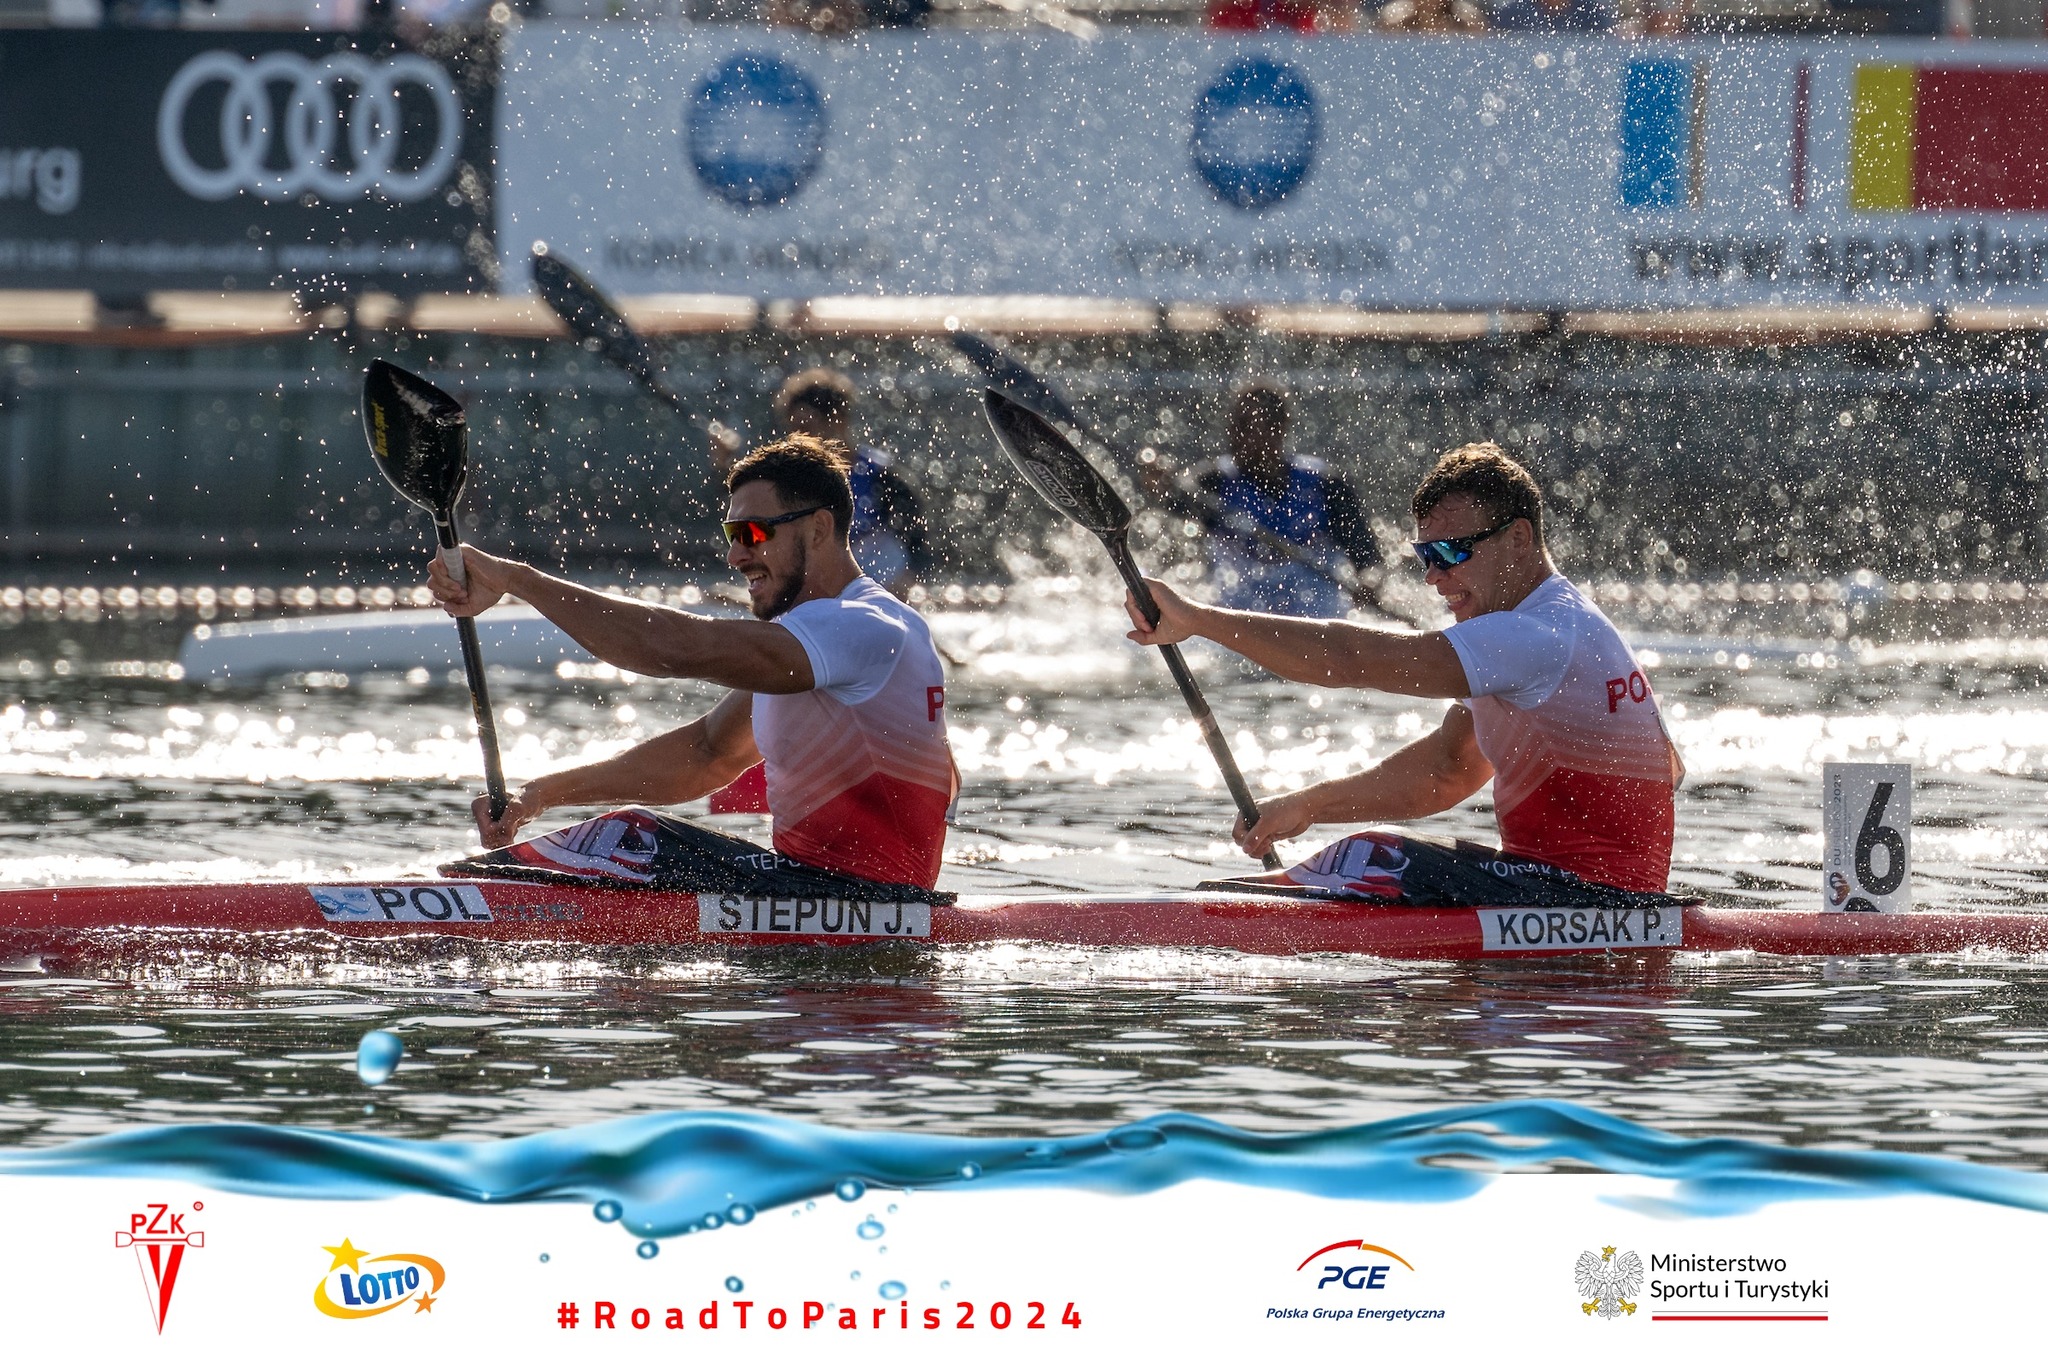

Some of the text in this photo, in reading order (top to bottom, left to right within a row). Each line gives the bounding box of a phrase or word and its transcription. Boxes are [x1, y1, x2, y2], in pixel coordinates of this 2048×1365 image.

[1605, 670, 1652, 714] PO
[1855, 782, 1906, 896] 6
[370, 887, 492, 921] POL
[717, 896, 913, 934] STEPUN J.
[1496, 909, 1665, 945] KORSAK P.
